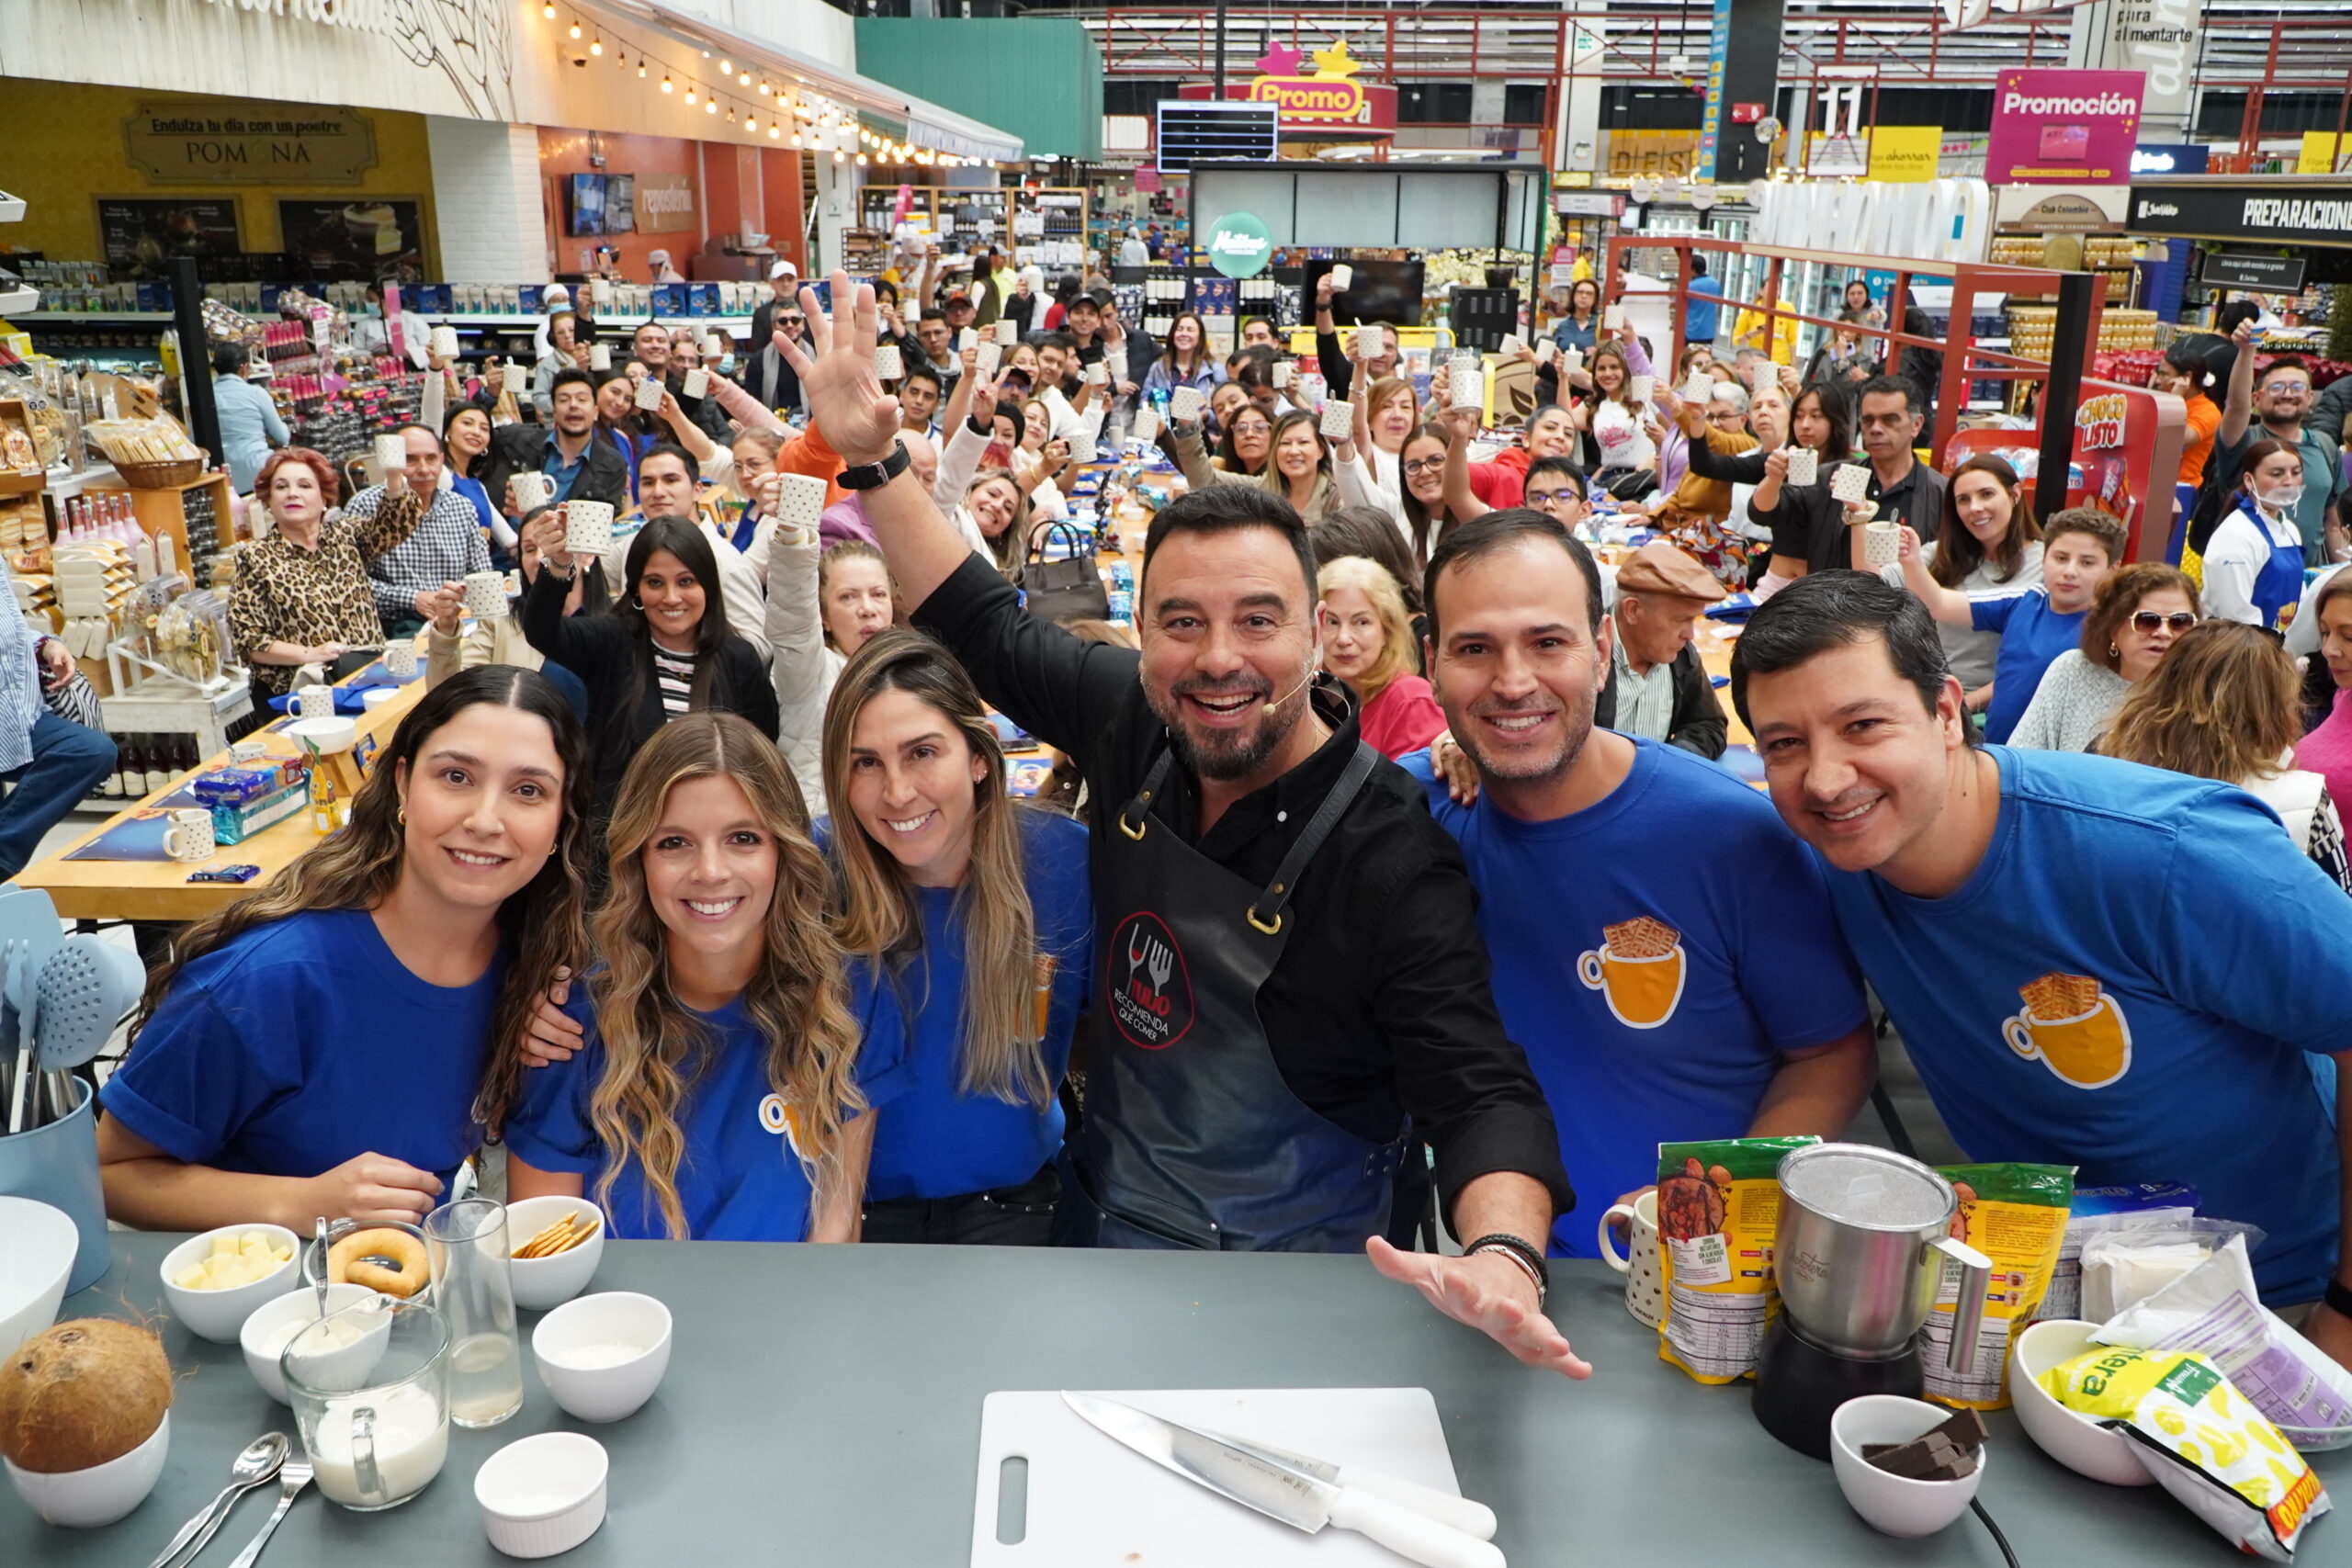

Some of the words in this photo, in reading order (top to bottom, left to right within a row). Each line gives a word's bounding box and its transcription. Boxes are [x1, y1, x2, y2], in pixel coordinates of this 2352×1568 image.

[1261, 85, 1351, 109] Promo
[2004, 91, 2137, 116] Promoción
[1817, 85, 1863, 136] 11
[152, 118, 204, 133] Endulza
[207, 118, 220, 132] tu
[224, 117, 244, 132] día
[249, 120, 273, 133] con
[277, 121, 293, 132] un
[294, 119, 342, 137] postre
[186, 141, 311, 164] POMONA
[1886, 148, 1931, 163] ahorrar
[2081, 395, 2125, 426] CHOCO
[2082, 422, 2119, 450] LISTO
[1114, 987, 1169, 1037] RECOMIENDA
[1133, 1017, 1157, 1042] COMER
